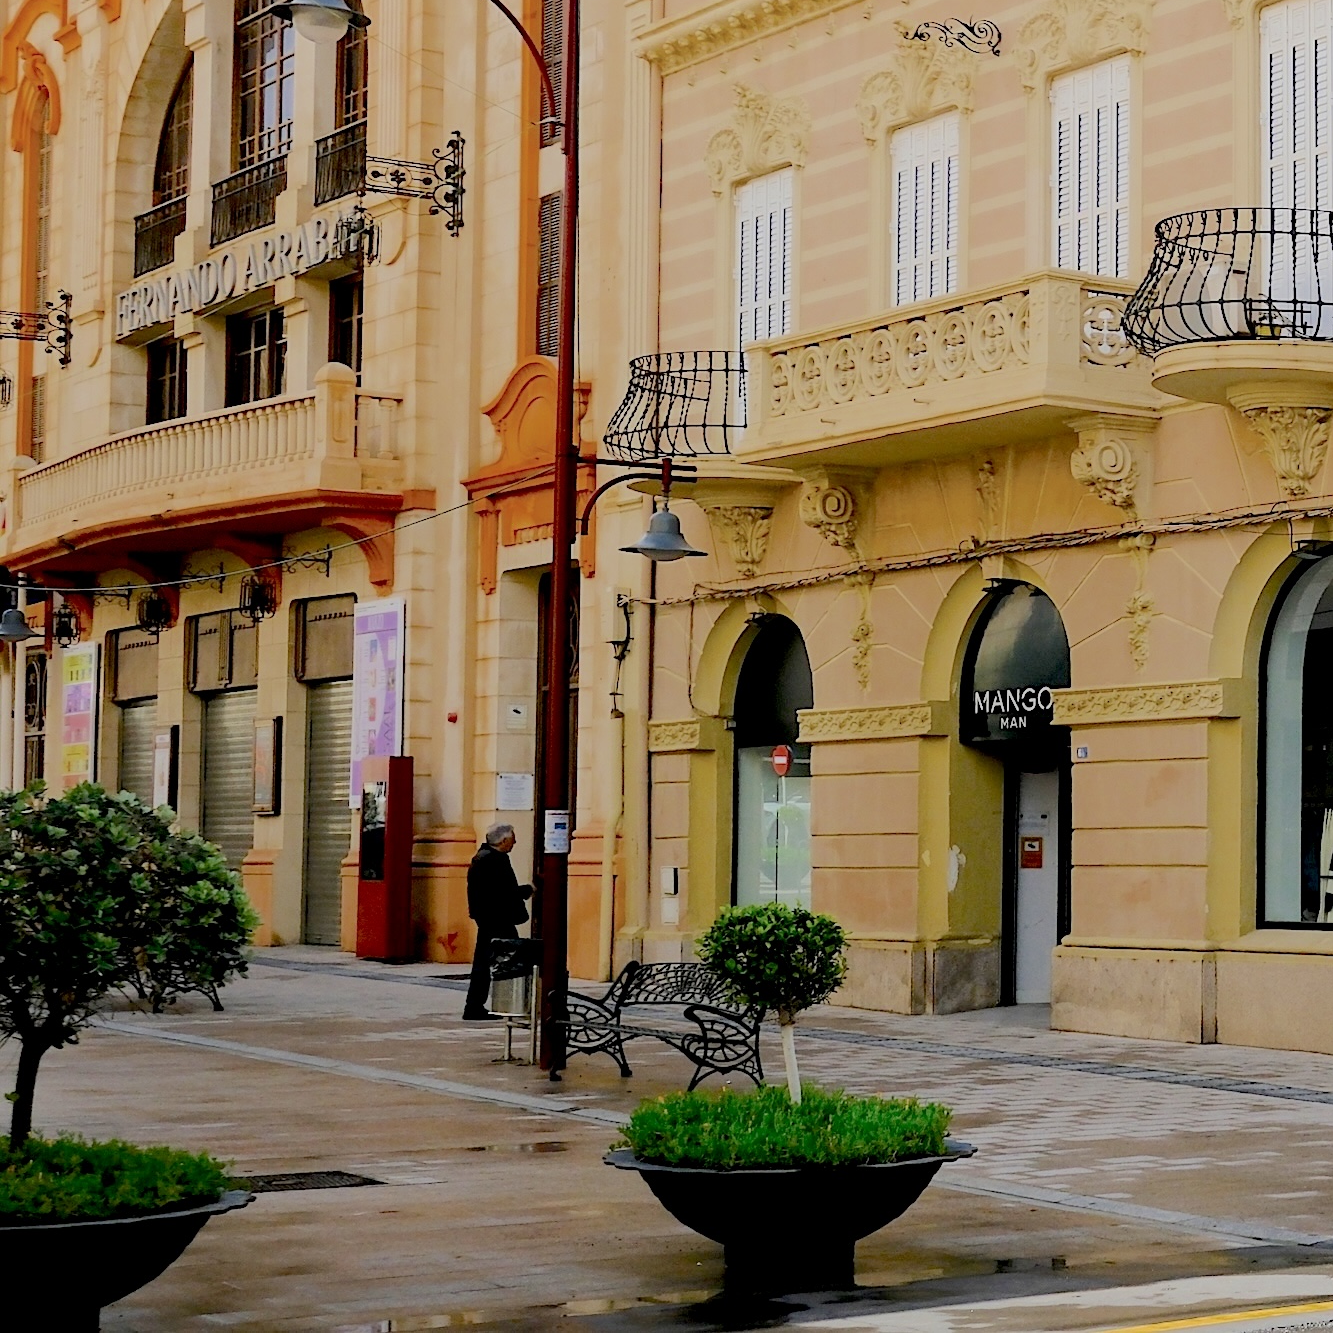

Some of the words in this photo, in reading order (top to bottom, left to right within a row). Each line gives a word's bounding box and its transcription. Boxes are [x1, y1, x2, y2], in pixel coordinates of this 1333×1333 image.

[115, 252, 237, 337] FERNANDO
[974, 686, 1053, 714] MANGO
[1000, 716, 1027, 729] MAN
